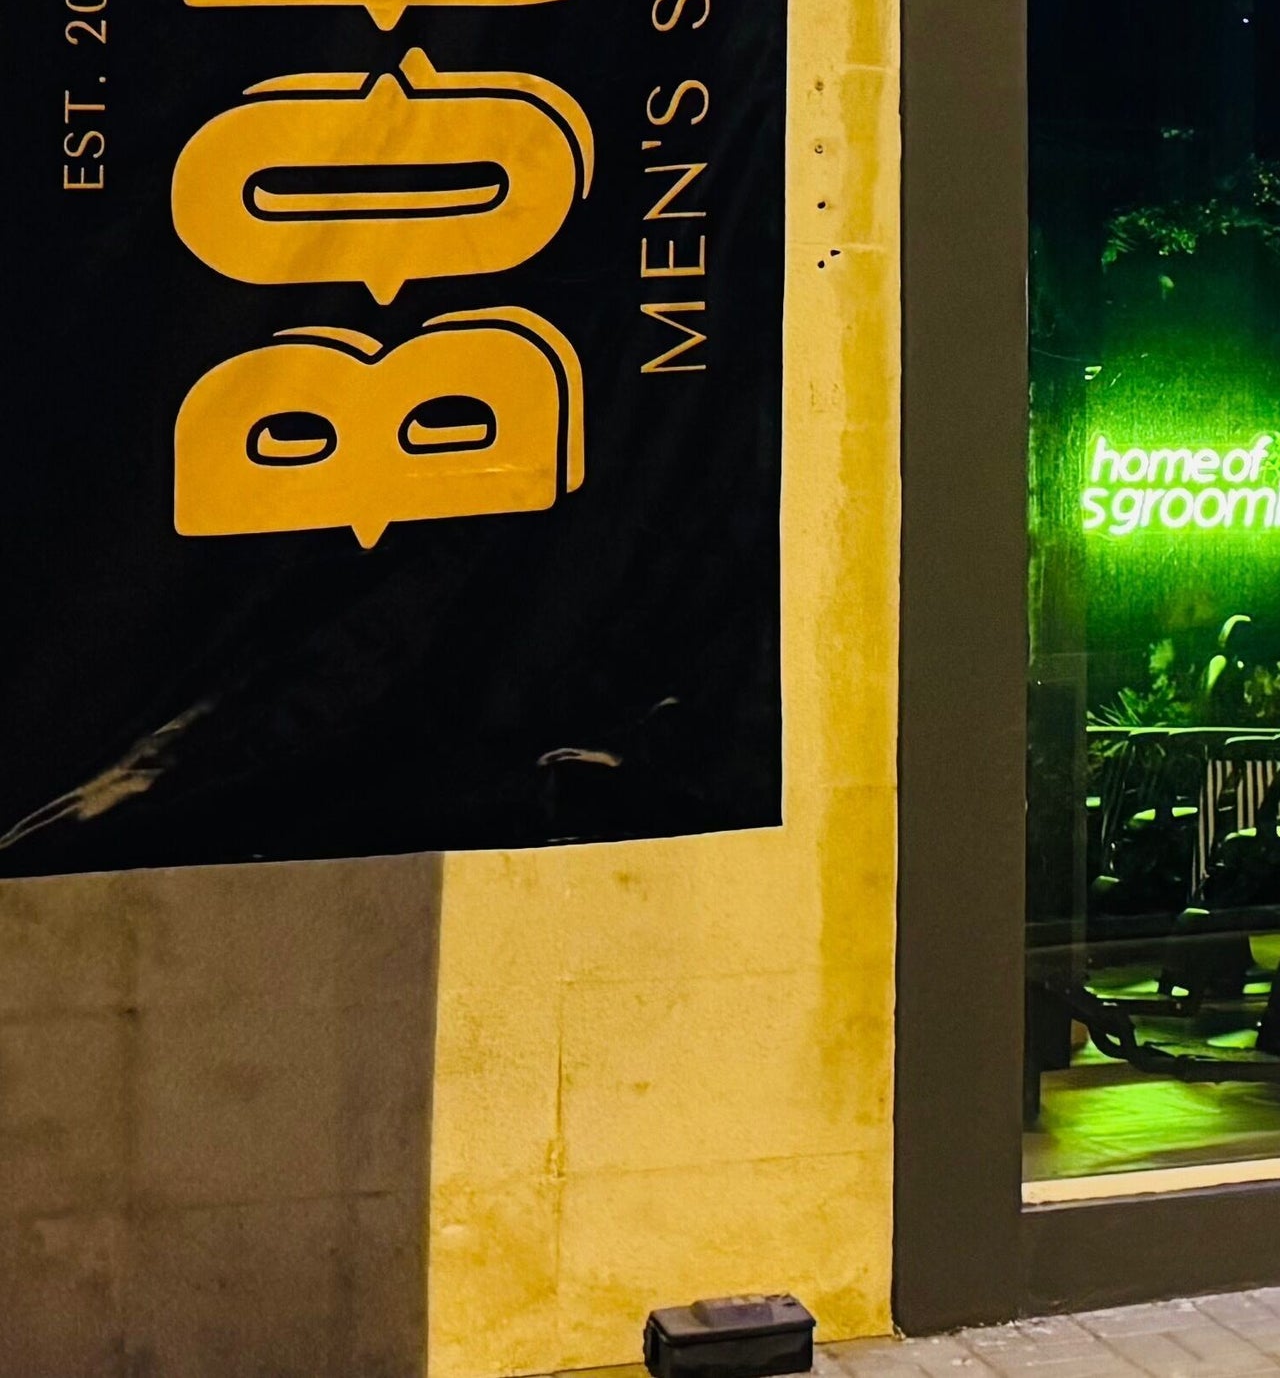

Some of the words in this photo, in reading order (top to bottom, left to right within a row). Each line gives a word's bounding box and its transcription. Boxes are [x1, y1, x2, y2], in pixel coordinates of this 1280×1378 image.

[63, 74, 106, 191] EST.
[639, 78, 711, 375] MEN'S
[1090, 435, 1220, 484] home
[1222, 434, 1274, 484] of
